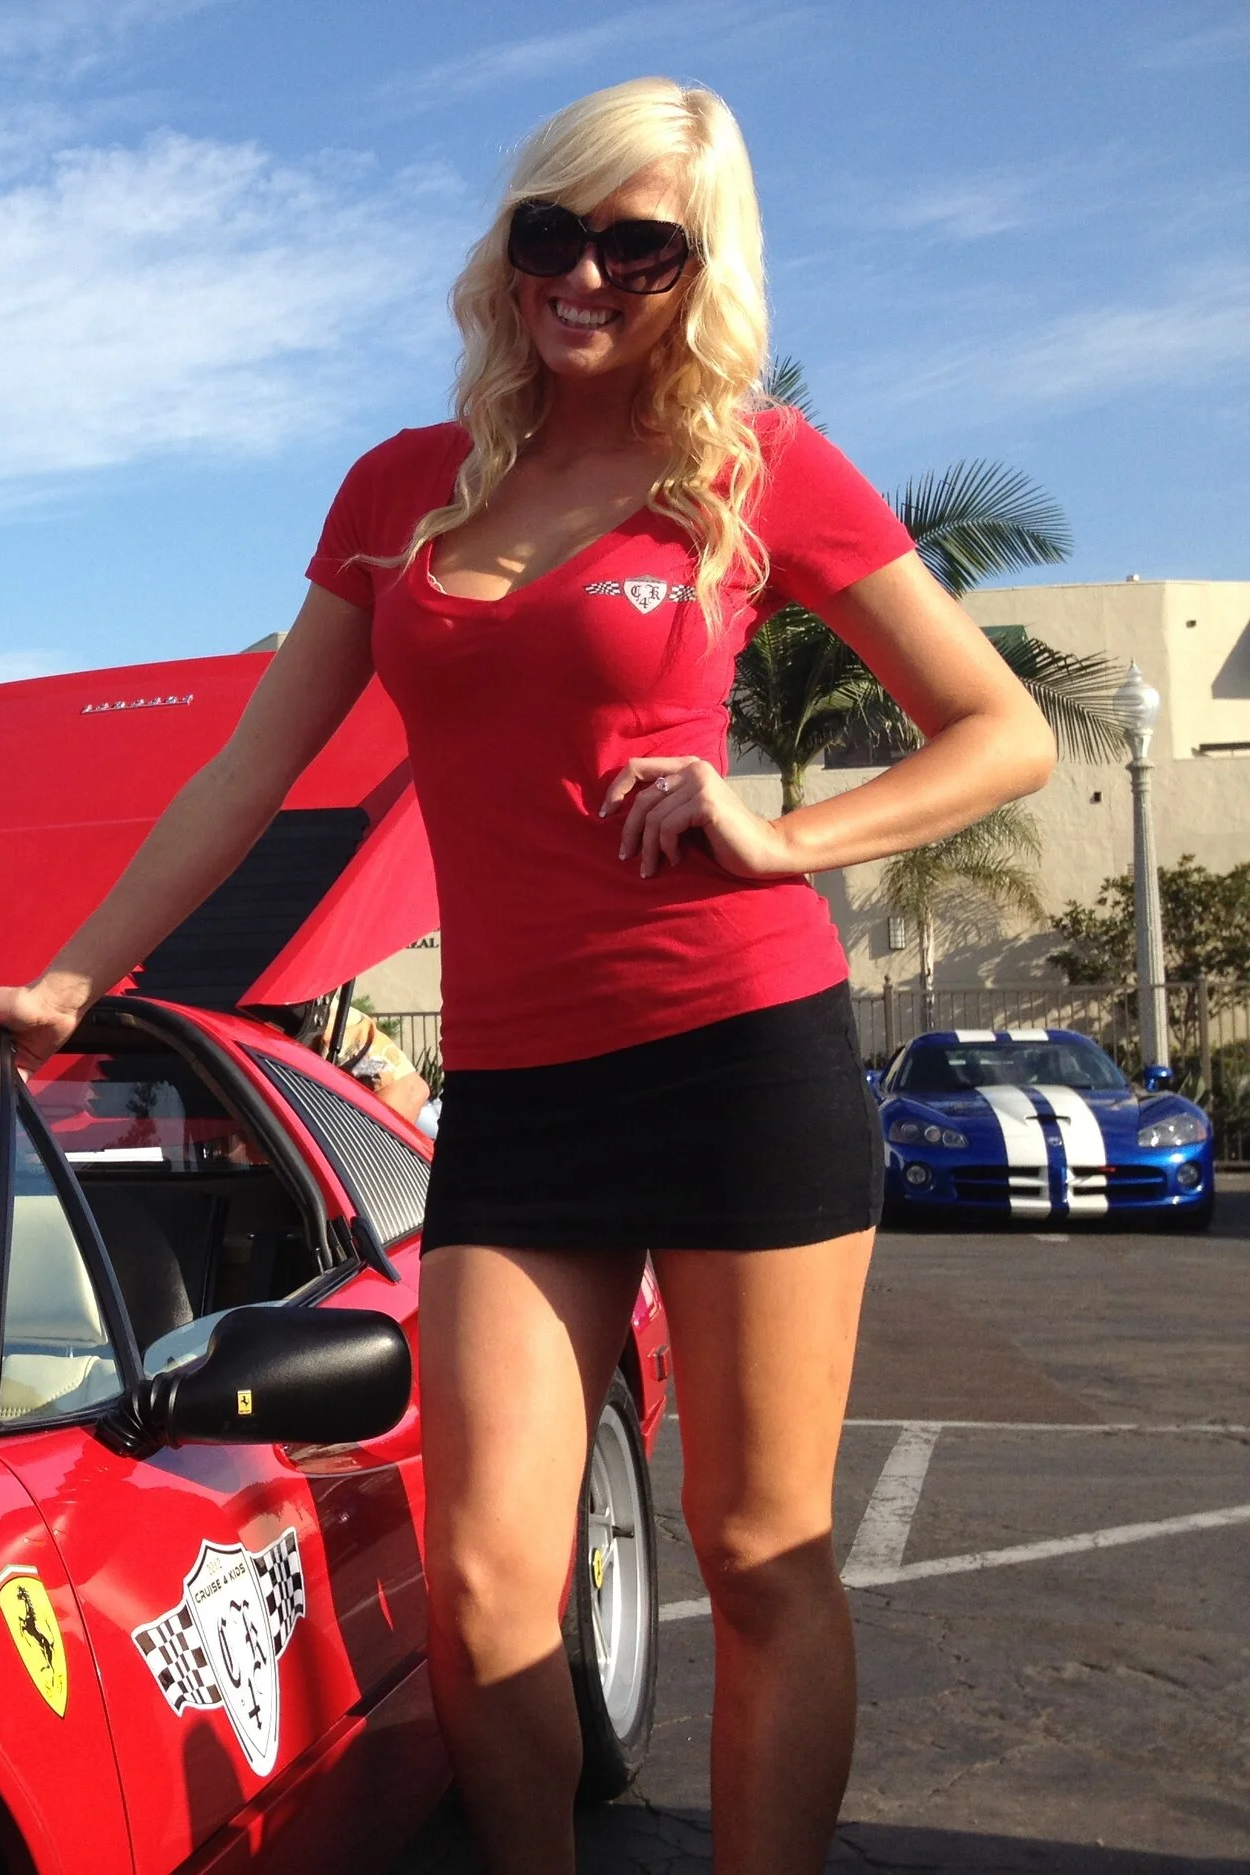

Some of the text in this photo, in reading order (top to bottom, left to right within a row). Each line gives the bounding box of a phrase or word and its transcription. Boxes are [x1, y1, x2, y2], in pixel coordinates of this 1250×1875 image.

[194, 1563, 247, 1604] CRUISE 4 KIDS
